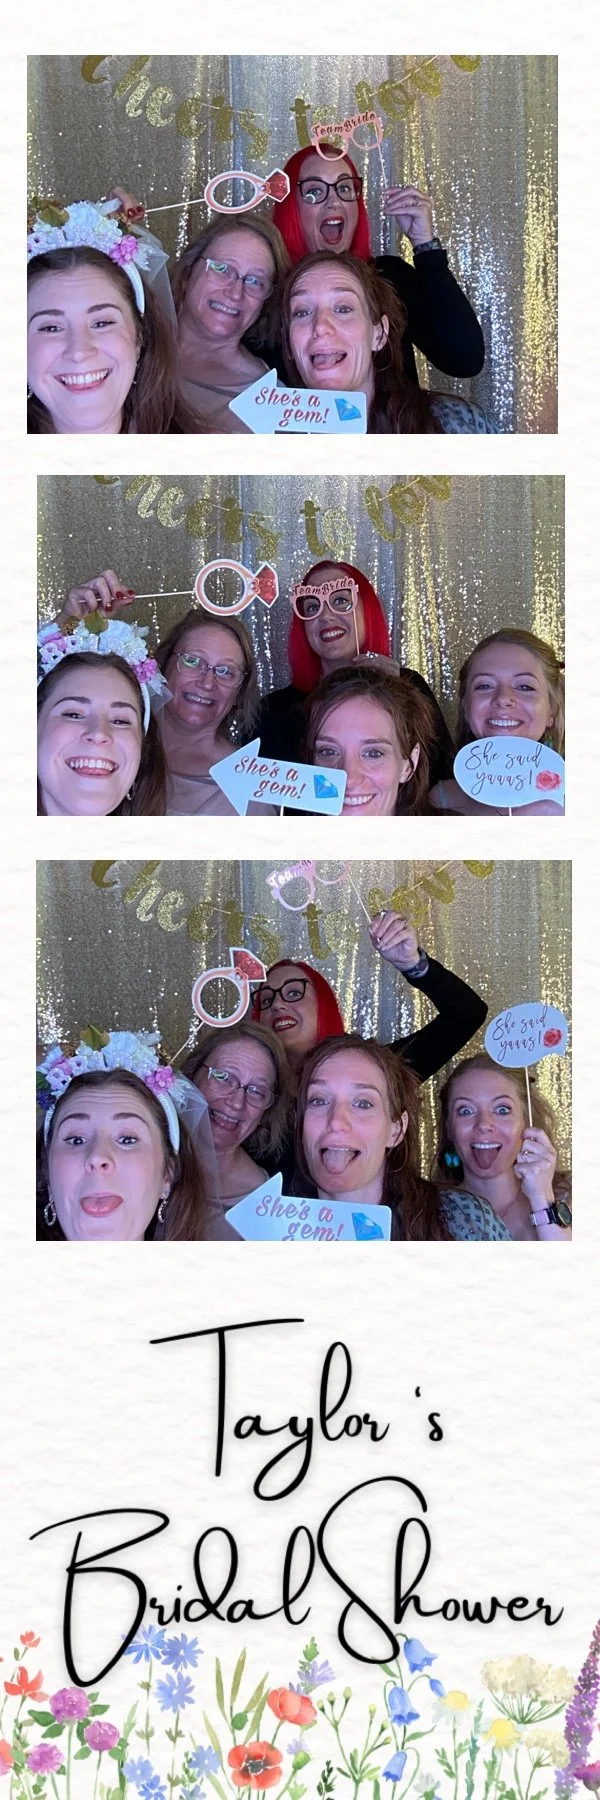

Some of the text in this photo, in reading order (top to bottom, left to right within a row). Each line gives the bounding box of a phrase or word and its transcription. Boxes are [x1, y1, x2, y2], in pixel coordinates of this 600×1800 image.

[255, 387, 320, 407] She's a
[279, 408, 330, 427] gem!
[300, 500, 356, 556] to
[235, 756, 299, 781] She's a
[465, 741, 543, 770] She said
[253, 779, 307, 798] gem!
[471, 770, 533, 796] yaaas!
[302, 903, 360, 960] to
[492, 1005, 548, 1040] She said
[497, 1030, 541, 1062] yaaas!
[255, 1194, 333, 1222] She's a
[282, 1222, 345, 1241] gem!
